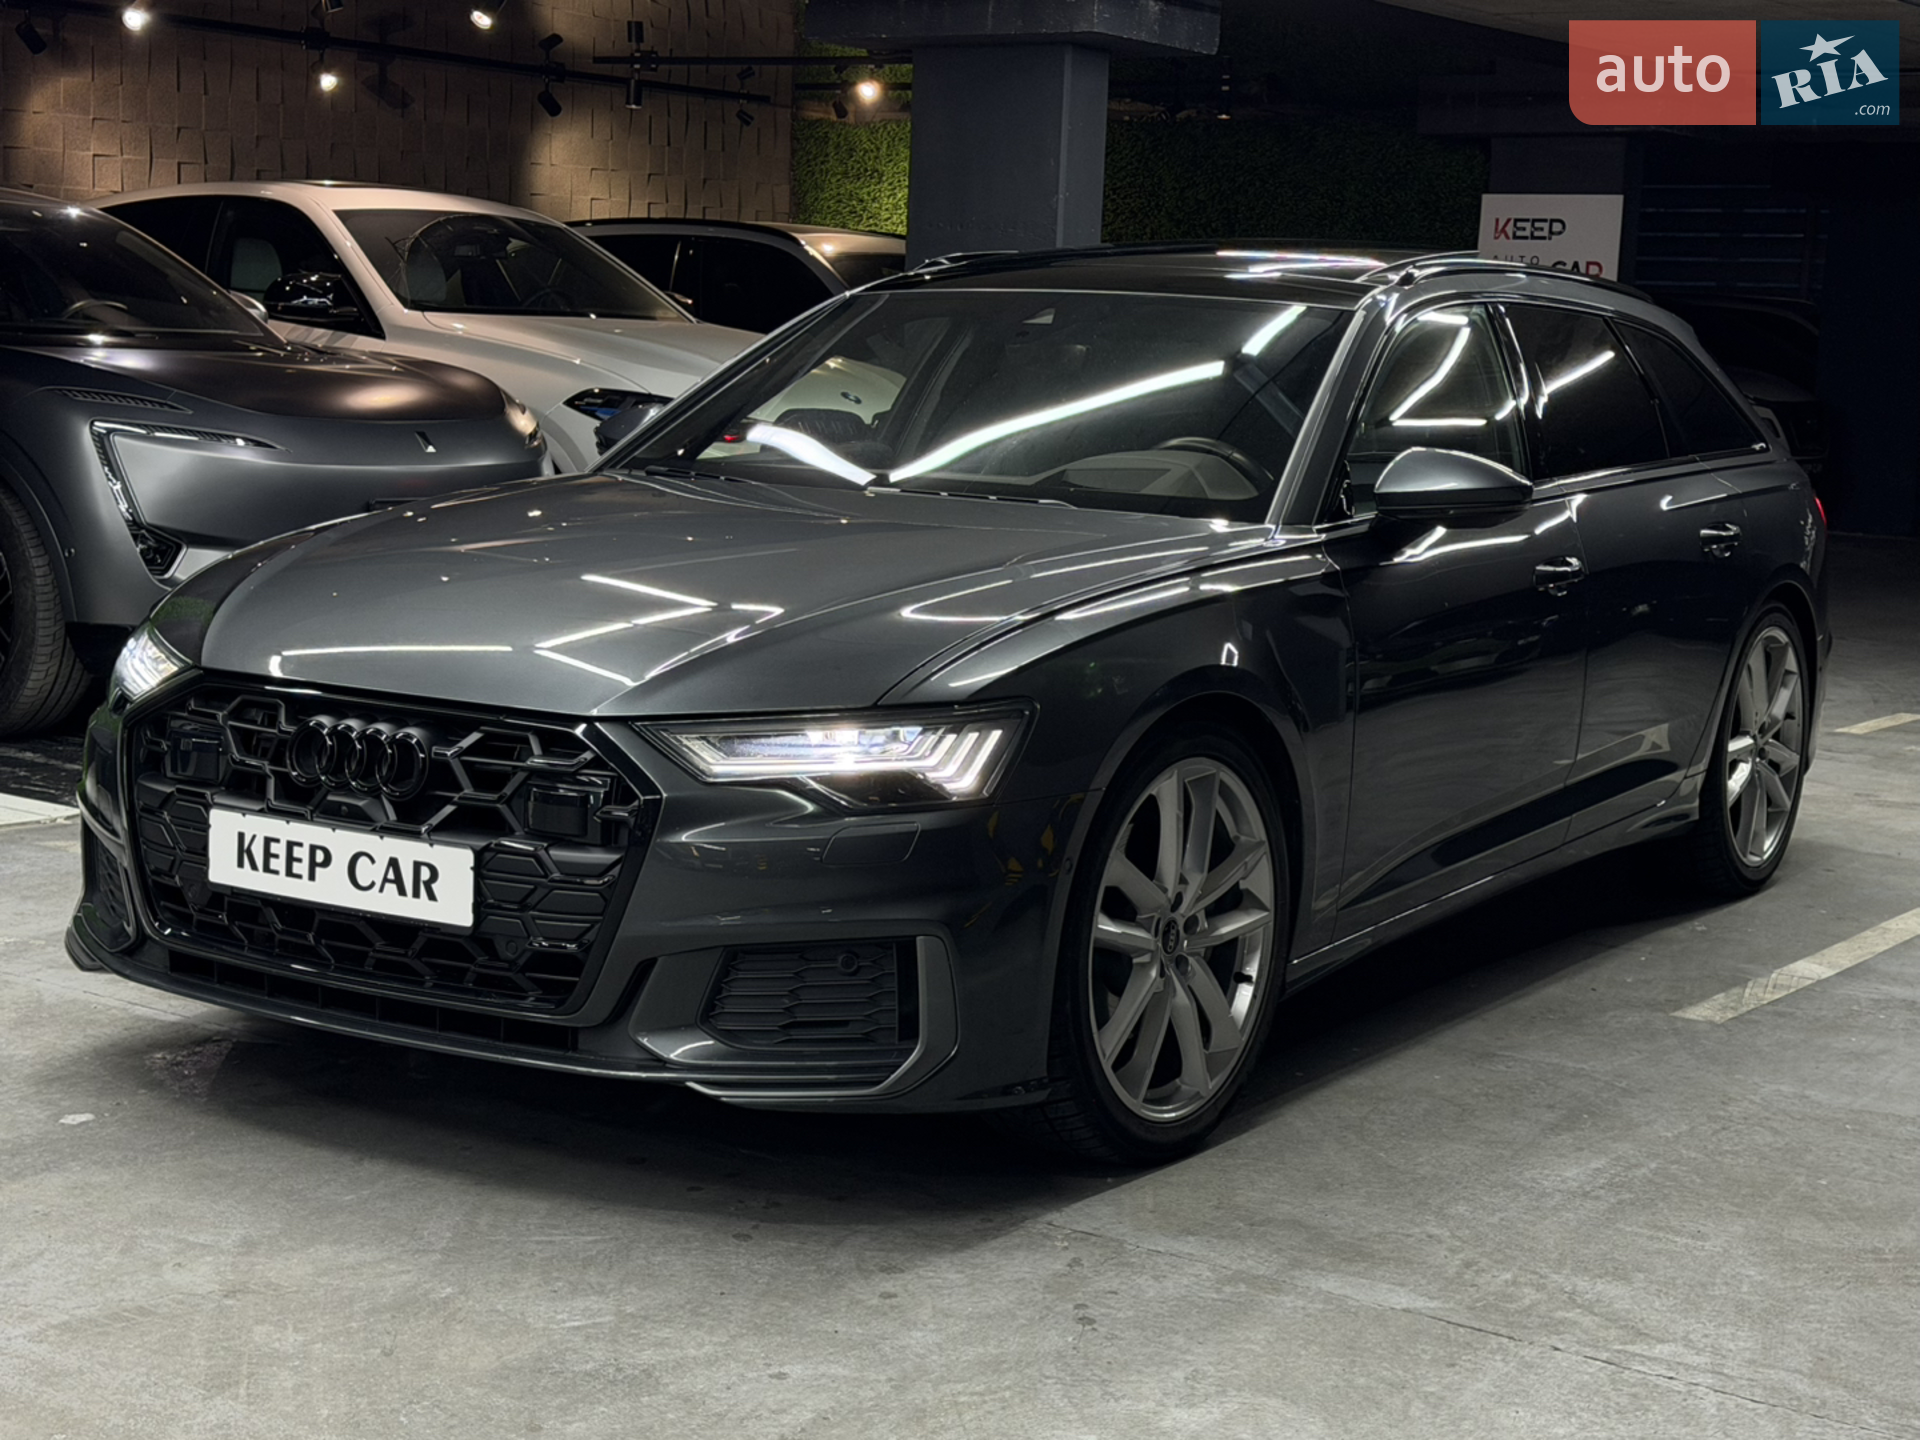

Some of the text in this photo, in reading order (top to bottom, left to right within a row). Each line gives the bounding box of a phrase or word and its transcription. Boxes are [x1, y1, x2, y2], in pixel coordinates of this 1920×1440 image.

[1493, 218, 1566, 241] KEEP
[236, 831, 440, 902] KEEP CAR
